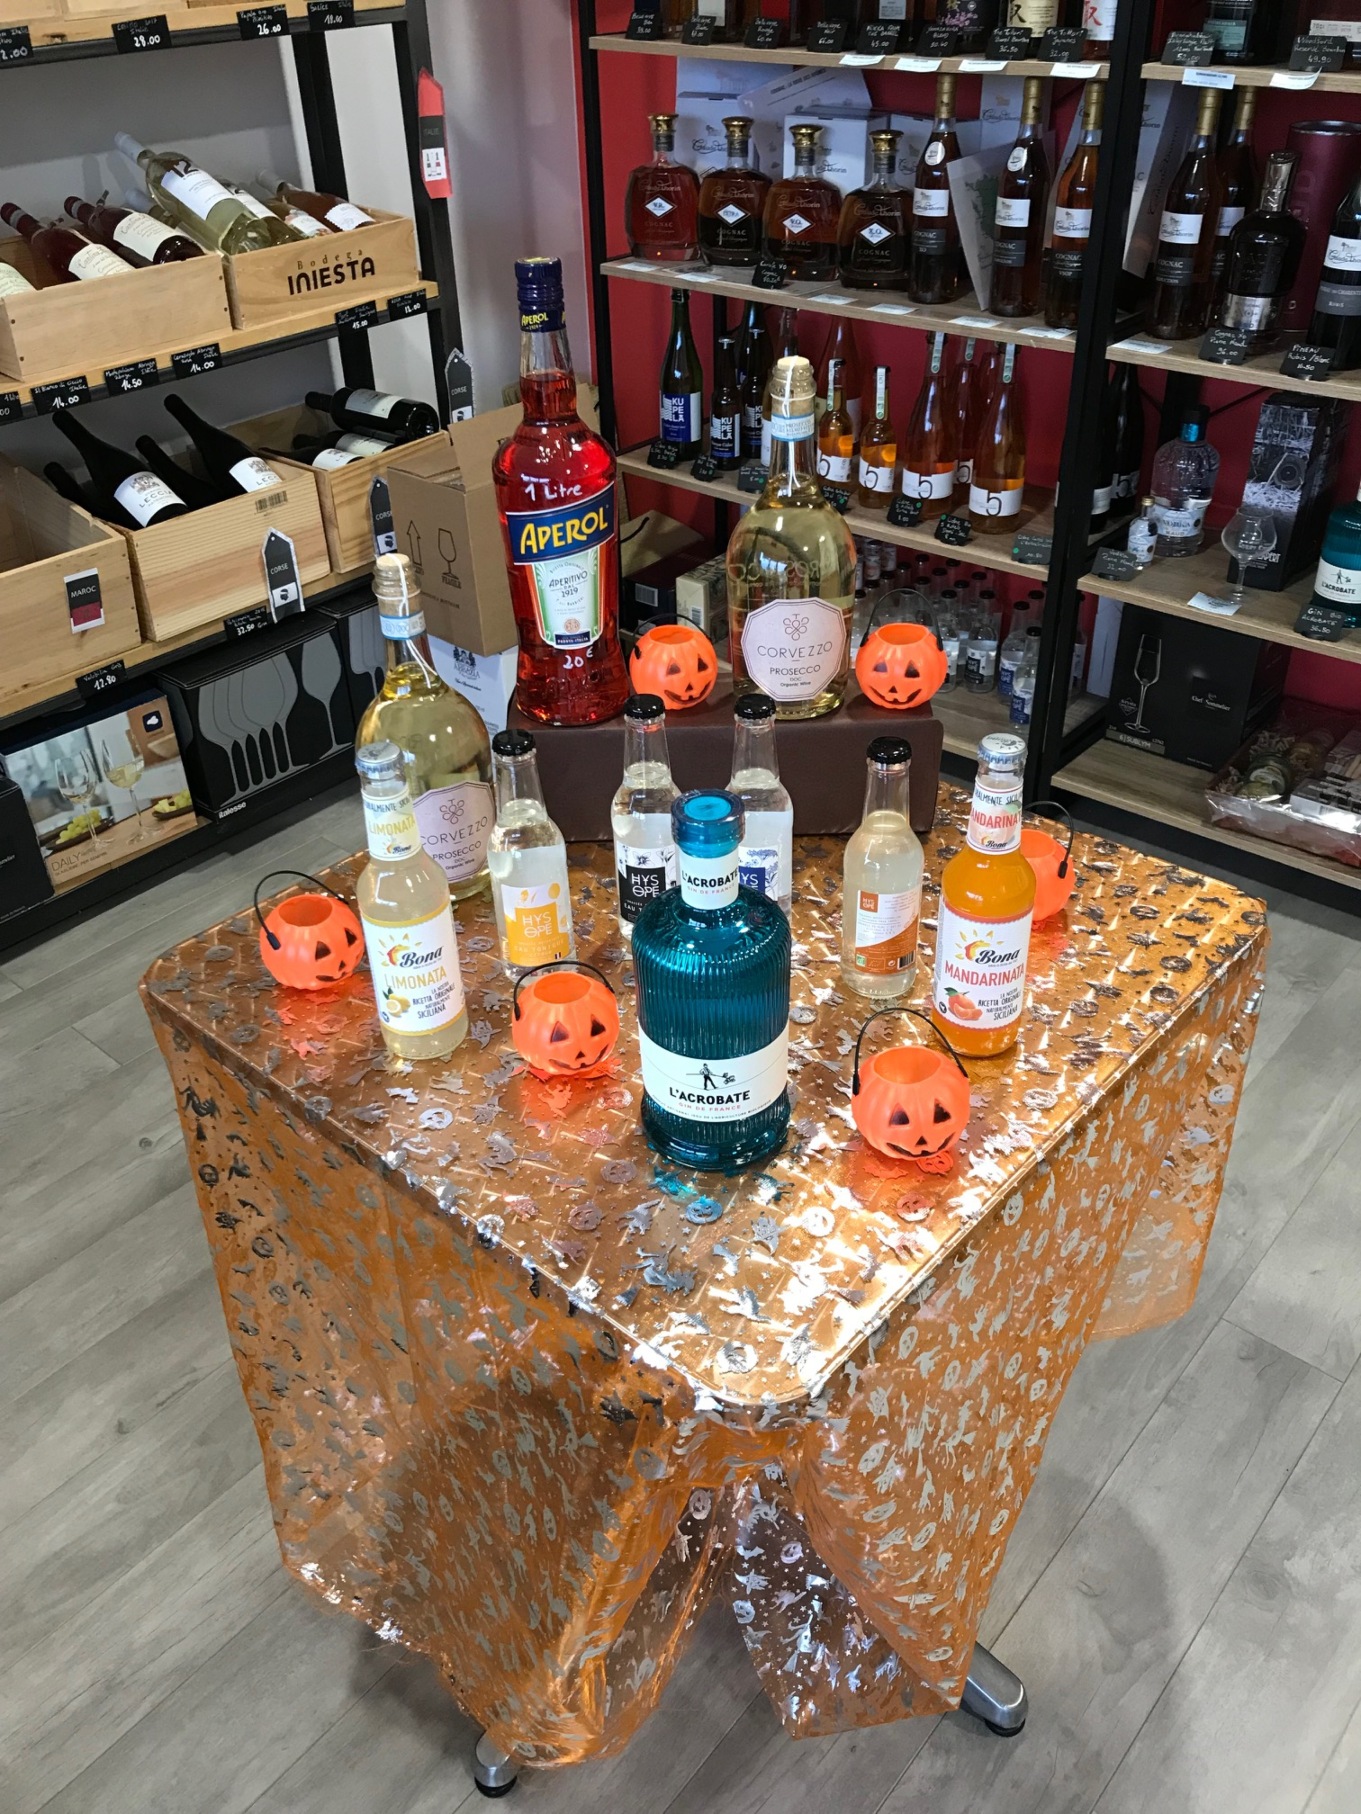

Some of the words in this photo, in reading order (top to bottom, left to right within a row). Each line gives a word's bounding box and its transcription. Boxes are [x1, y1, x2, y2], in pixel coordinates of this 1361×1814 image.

[257, 22, 282, 35] 26.00
[134, 34, 161, 48] 28.00
[296, 249, 363, 270] Bodega
[287, 256, 376, 296] INIESTA
[521, 311, 549, 327] APEROL
[190, 360, 215, 374] 14.00
[121, 378, 143, 391] 14.50
[451, 386, 468, 396] CORSE
[52, 394, 80, 409] 14.00
[672, 397, 684, 406] KU
[672, 406, 684, 414] PE
[721, 417, 733, 425] KU
[863, 466, 879, 490] 5
[956, 464, 972, 484] 5
[525, 483, 537, 502] 1
[543, 481, 584, 499] Litre
[918, 473, 934, 500] 5
[985, 491, 1003, 517] 5
[519, 506, 609, 556] APEROL
[269, 563, 289, 575] CORSE
[548, 570, 589, 589] APERITIVO
[70, 585, 97, 599] MAROC
[561, 587, 579, 599] 1919
[756, 641, 833, 658] CORVEZZO
[562, 654, 584, 670] 20
[769, 664, 821, 676] PROSECCO
[93, 674, 117, 691] 12.80
[218, 801, 247, 819] italesse
[432, 840, 482, 861] PROSECCO
[985, 839, 1007, 848] Bona
[51, 851, 81, 872] DAILY
[631, 873, 659, 888] HYS
[682, 866, 739, 888] L'ACROBATE
[739, 874, 759, 885] YS
[522, 911, 552, 927] HYS
[399, 946, 444, 969] Bona
[975, 947, 1023, 965] Bona
[384, 965, 448, 990] LIMONATA
[944, 959, 1025, 987] MANDARINATA
[417, 1003, 447, 1019] SICILIANA
[993, 1004, 1018, 1021] SICILIANA
[669, 1086, 751, 1105] L'ACROBATE
[678, 1101, 693, 1110] GIN
[709, 1104, 742, 1112] FRANCE
